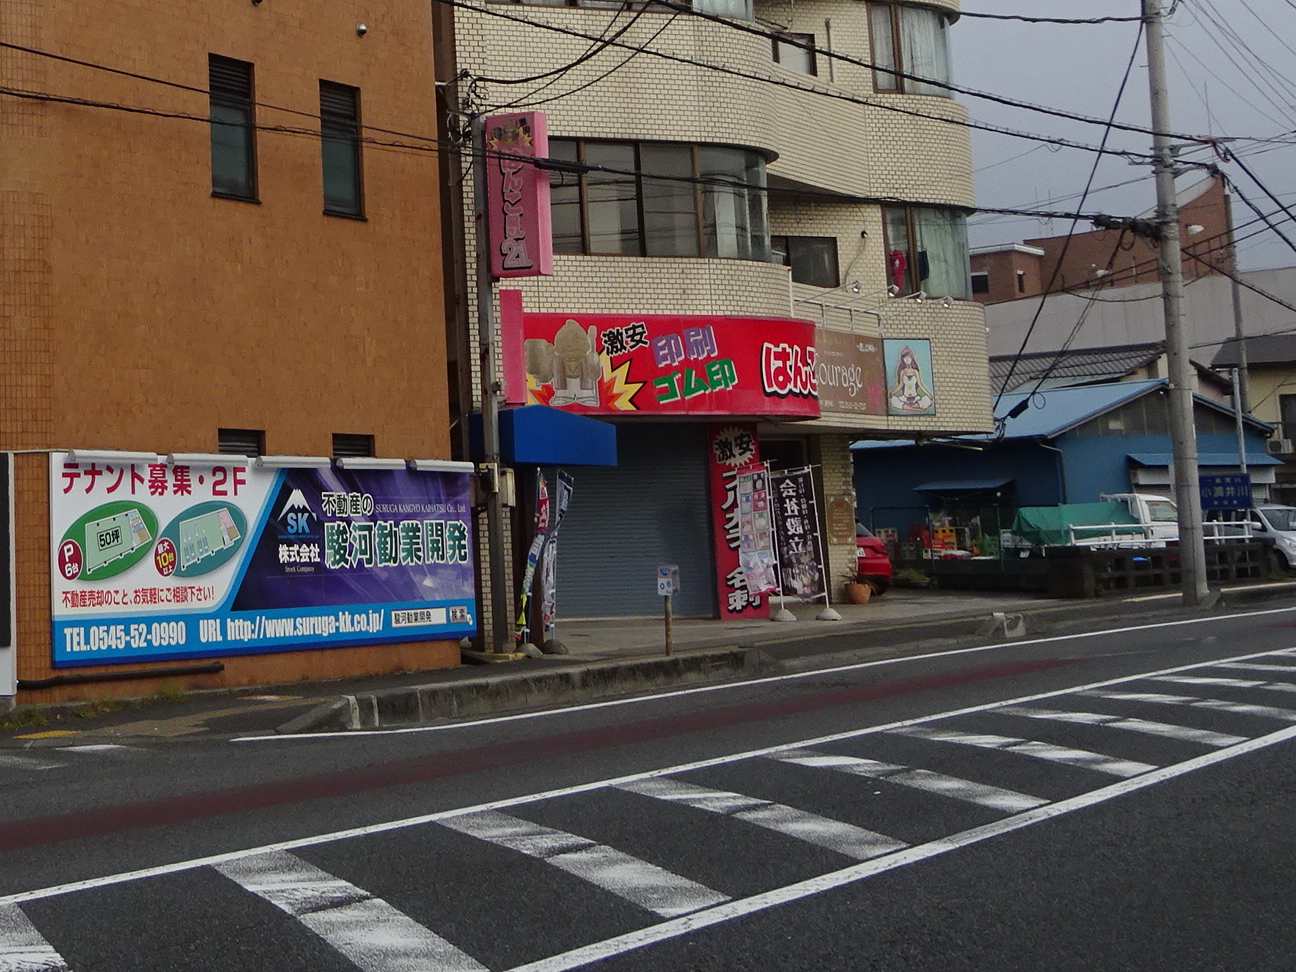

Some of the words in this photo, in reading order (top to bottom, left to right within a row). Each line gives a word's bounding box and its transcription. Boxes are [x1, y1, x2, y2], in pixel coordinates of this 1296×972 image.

[601, 322, 650, 356] 激安
[651, 324, 718, 367] 印刷
[653, 358, 739, 404] ゴム印
[815, 352, 864, 397] ourage
[714, 432, 754, 461] 激安
[321, 491, 374, 517] 不動産の
[375, 504, 398, 513] SURUGA
[287, 512, 310, 534] SK
[98, 529, 120, 547] 50坪
[324, 520, 469, 569] 駿河勧業開発
[64, 544, 74, 562] P
[156, 552, 174, 569] 10台
[278, 543, 320, 563] 株式会社
[65, 563, 79, 577] 6台
[64, 621, 186, 652] TEL.0545-52-0990
[199, 619, 222, 643] URL
[227, 609, 384, 641] http://www.suruga-kk.co.jp/
